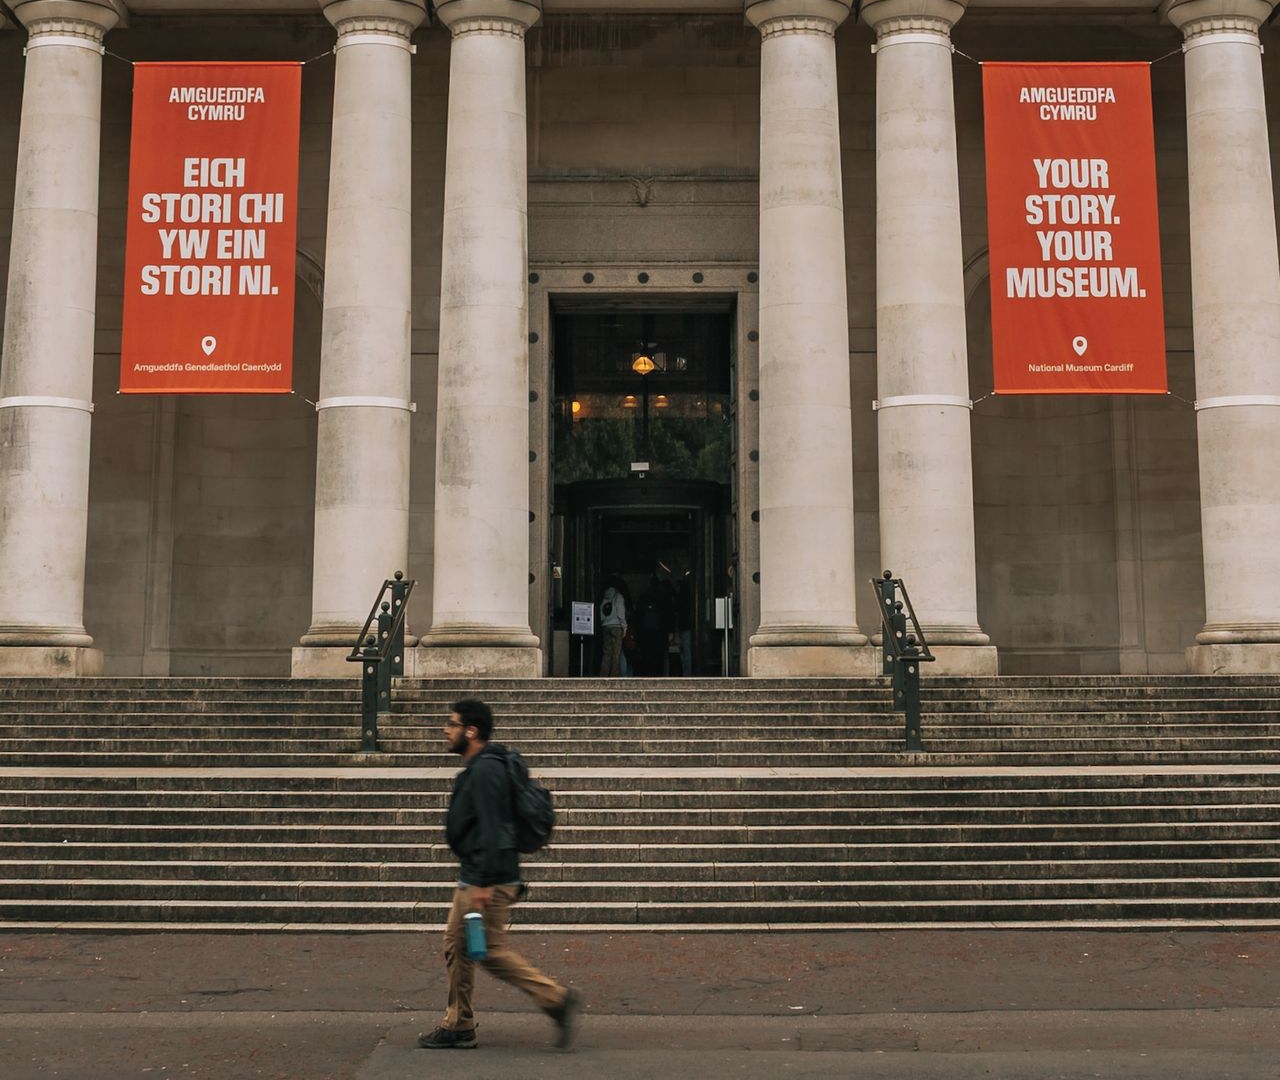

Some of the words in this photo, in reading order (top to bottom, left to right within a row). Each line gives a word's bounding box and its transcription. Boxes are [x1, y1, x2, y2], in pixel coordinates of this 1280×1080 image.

[169, 87, 265, 103] AMGUEDDFA
[1019, 87, 1116, 103] AMGUEDDFA
[187, 104, 245, 121] CYMRU
[1039, 104, 1097, 121] CYMRU
[183, 157, 245, 188] EICH
[1033, 158, 1109, 189] YOUR
[141, 193, 232, 224] STORI
[238, 193, 284, 223] CHI
[1025, 194, 1120, 225] STORY.
[158, 229, 210, 260] YW
[217, 229, 266, 259] EIN
[1036, 230, 1113, 261] YOUR
[140, 265, 231, 296] STORI
[238, 265, 279, 295] NI.
[1006, 266, 1147, 298] MUSEUM.
[133, 363, 183, 373] Amgueddfa
[185, 363, 240, 372] Genedlaethol
[242, 363, 282, 373] Caerdydd
[1028, 363, 1064, 372] National
[1065, 363, 1103, 372] Museum
[1104, 363, 1134, 372] Cardiff
